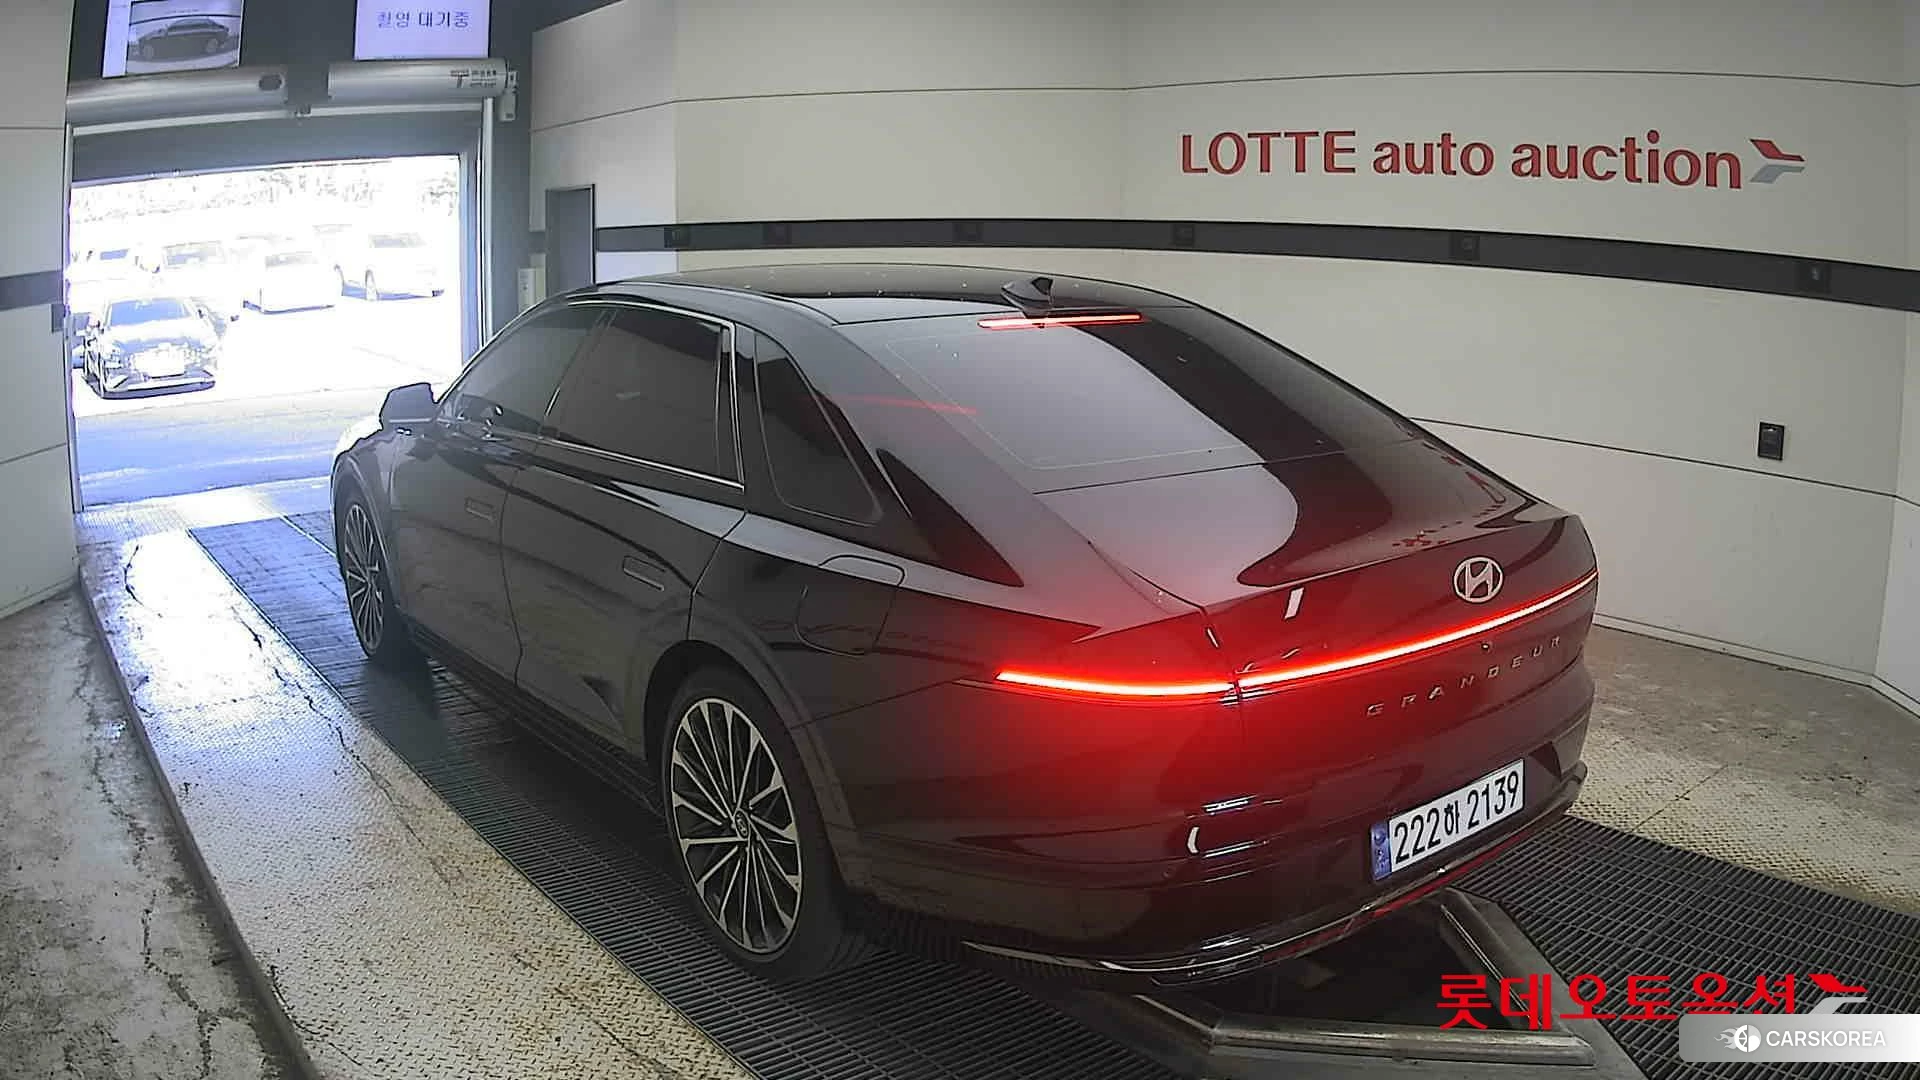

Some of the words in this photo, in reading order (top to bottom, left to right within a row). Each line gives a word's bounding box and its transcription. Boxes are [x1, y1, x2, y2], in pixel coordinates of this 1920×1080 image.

[419, 11, 469, 28] 대기중
[1180, 130, 1357, 175] LOTTE
[1372, 132, 1496, 177] auto
[1510, 129, 1743, 190] auction
[1366, 634, 1561, 718] GRANDEUR
[1394, 801, 1460, 864] 222하
[1467, 771, 1519, 829] 2139
